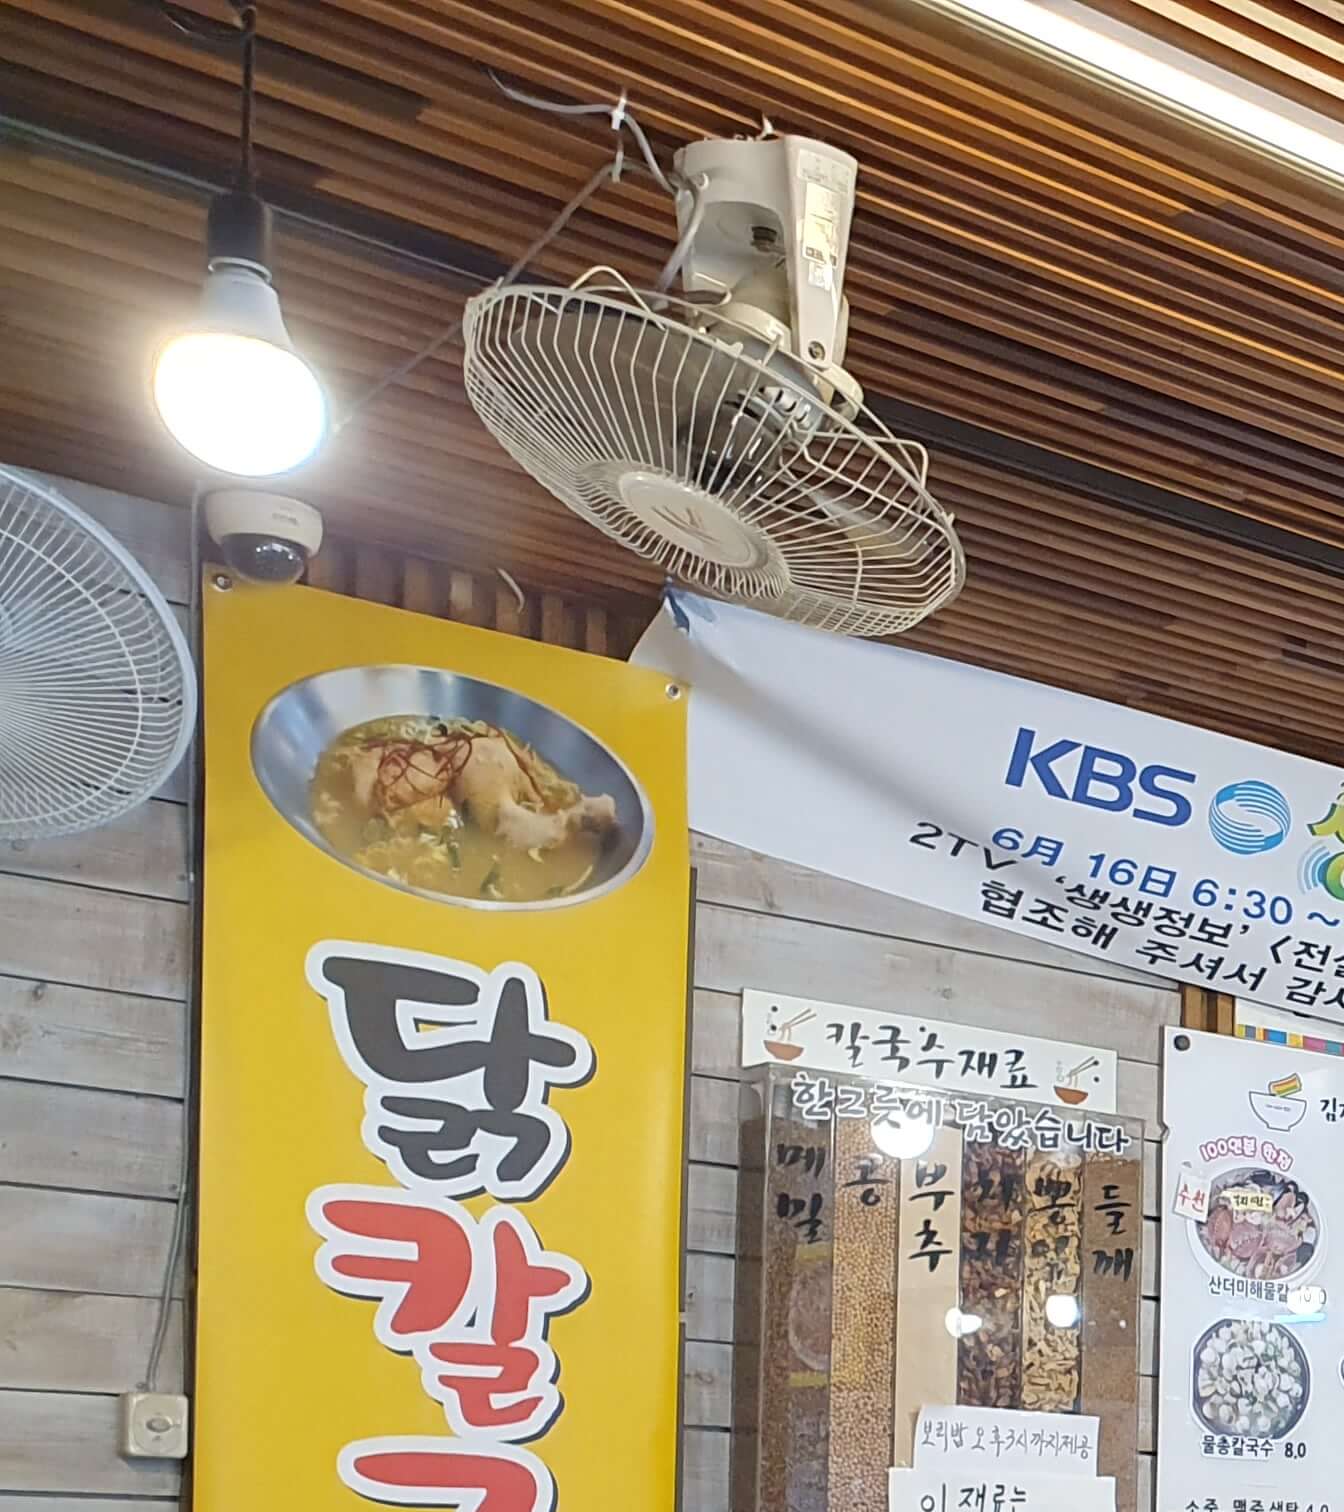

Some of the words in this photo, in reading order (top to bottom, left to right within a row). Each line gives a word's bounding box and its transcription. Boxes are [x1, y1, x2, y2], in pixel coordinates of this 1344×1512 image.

[1005, 727, 1197, 827] KBS
[909, 822, 1017, 870] 2TV
[1192, 879, 1293, 925] 6:30
[980, 879, 1120, 951] 협조해
[1135, 938, 1267, 992] 주셔서
[955, 1099, 1130, 1155] 담았습니다
[843, 1154, 892, 1207] 콩
[908, 1162, 956, 1273] 부추
[1284, 1442, 1307, 1460] 8.0
